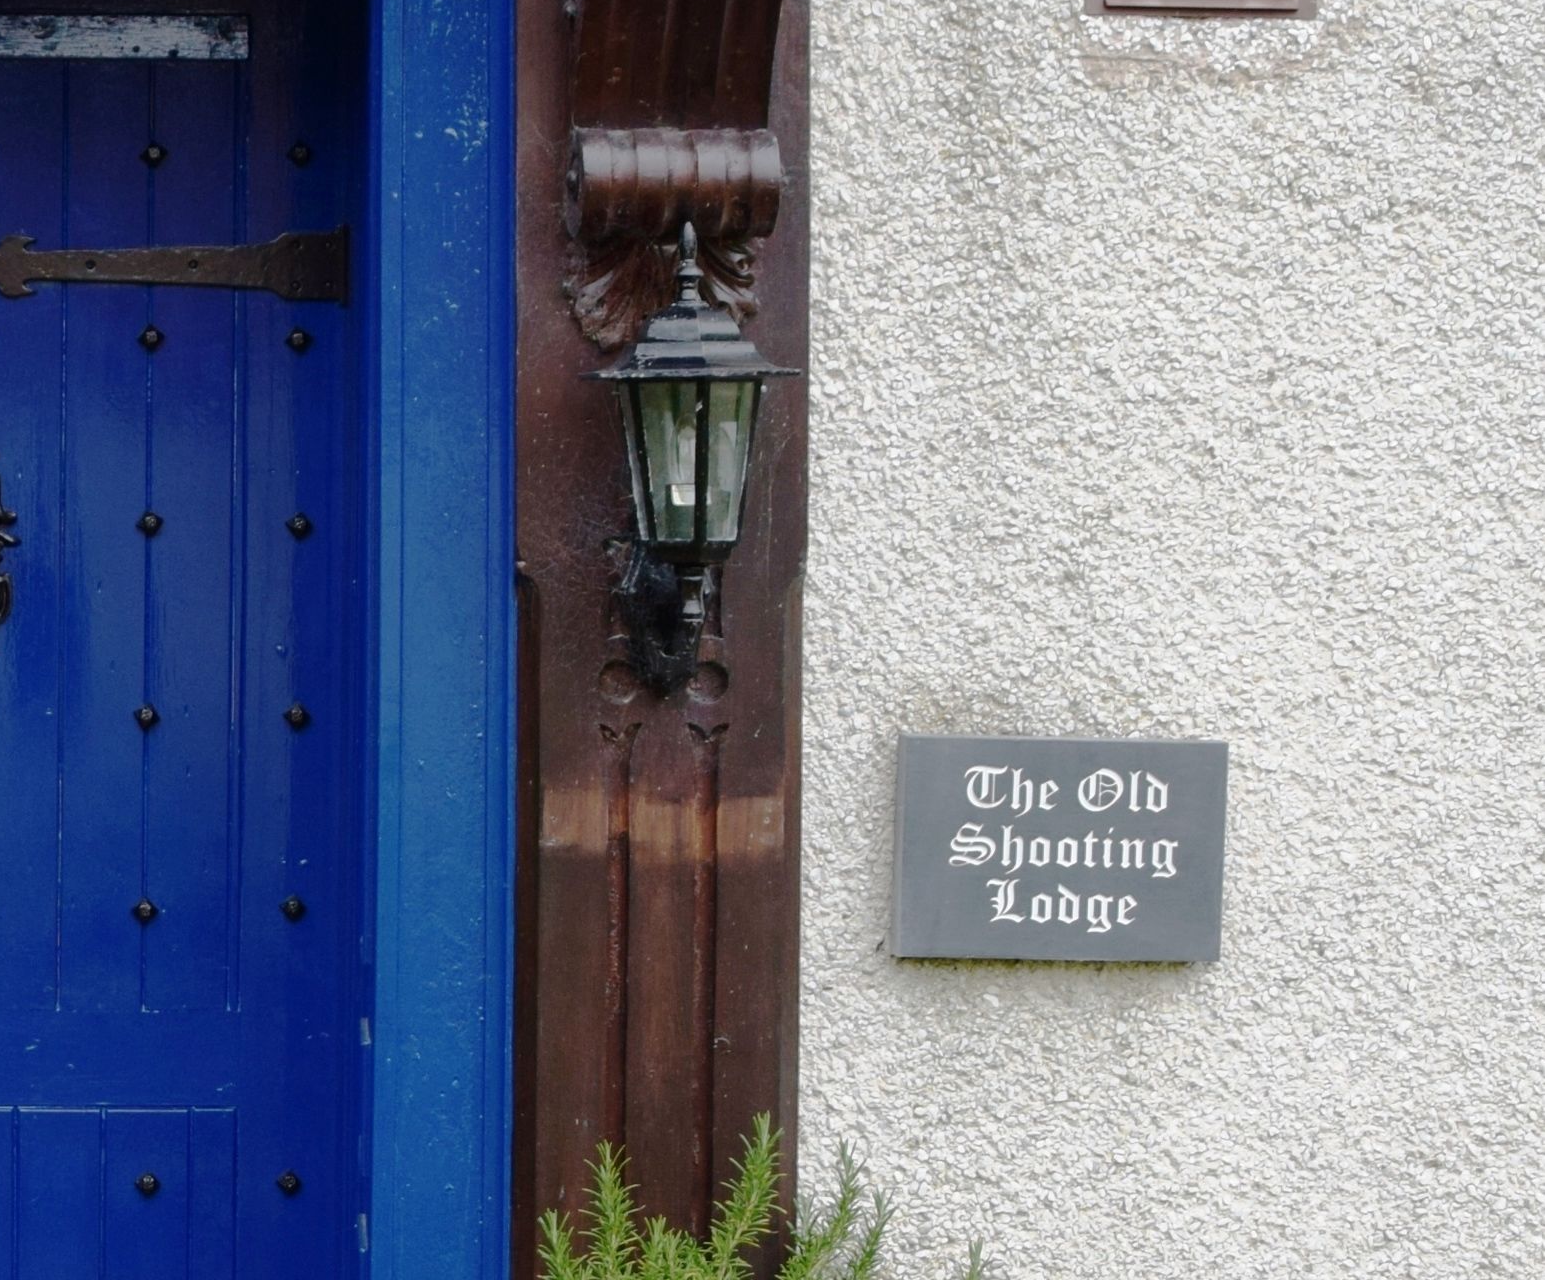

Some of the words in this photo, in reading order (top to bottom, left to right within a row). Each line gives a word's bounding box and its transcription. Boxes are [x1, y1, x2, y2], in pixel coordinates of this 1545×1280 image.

[964, 765, 1059, 817] The
[1077, 768, 1169, 813] Old
[948, 822, 1179, 878] Shooting
[986, 878, 1138, 933] Lodge
